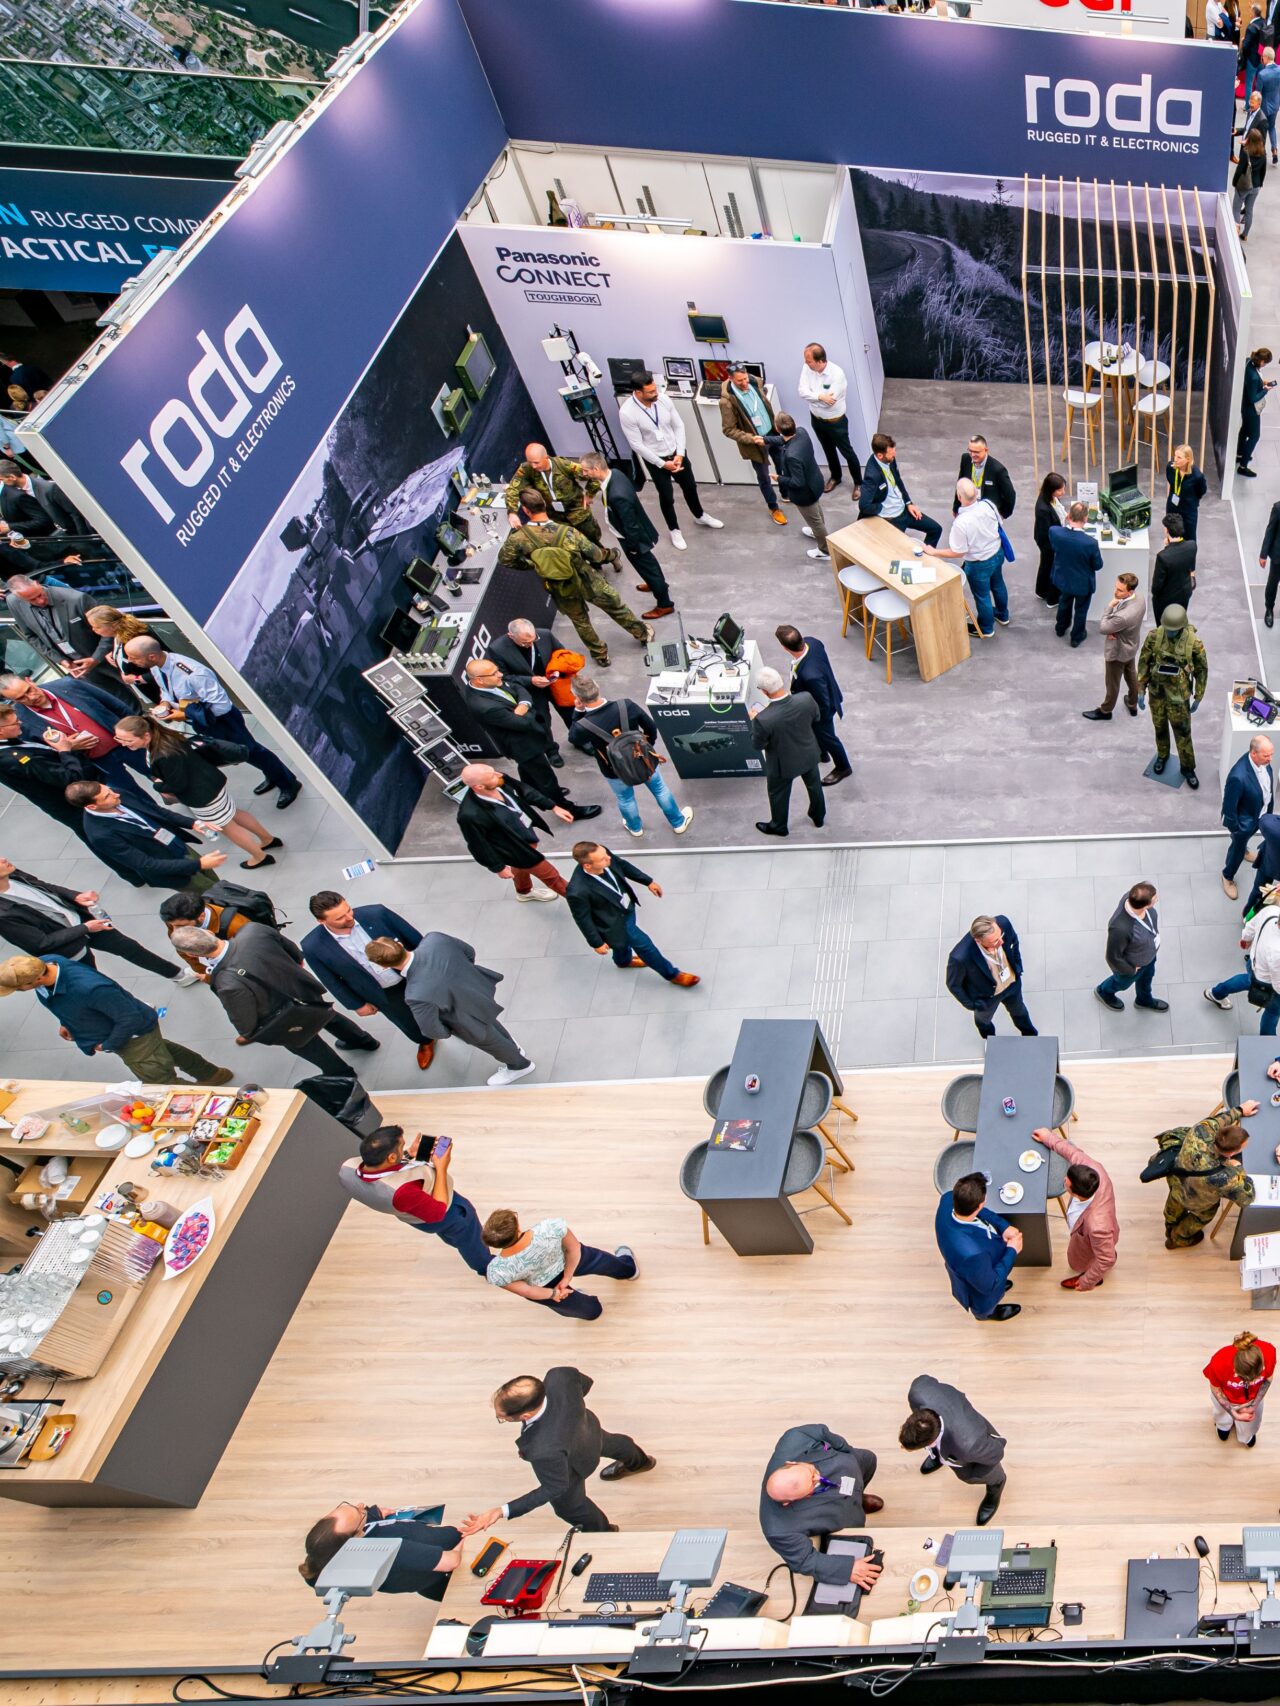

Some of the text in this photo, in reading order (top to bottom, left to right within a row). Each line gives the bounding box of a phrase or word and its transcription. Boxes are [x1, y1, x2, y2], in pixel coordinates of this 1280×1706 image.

[1025, 73, 1203, 137] roda
[1027, 130, 1199, 154] RUGGED IT & ELECTRONICS
[0, 203, 203, 235] N RUGGED COMP
[0, 236, 143, 265] ACTICAL
[496, 247, 600, 267] Panasonic
[496, 265, 611, 288] CONNECT
[528, 293, 598, 304] TOUGHBOOK
[120, 304, 283, 525] roda
[176, 375, 296, 547] RUGGED IT & ELECTRONICS
[657, 709, 690, 717] roda
